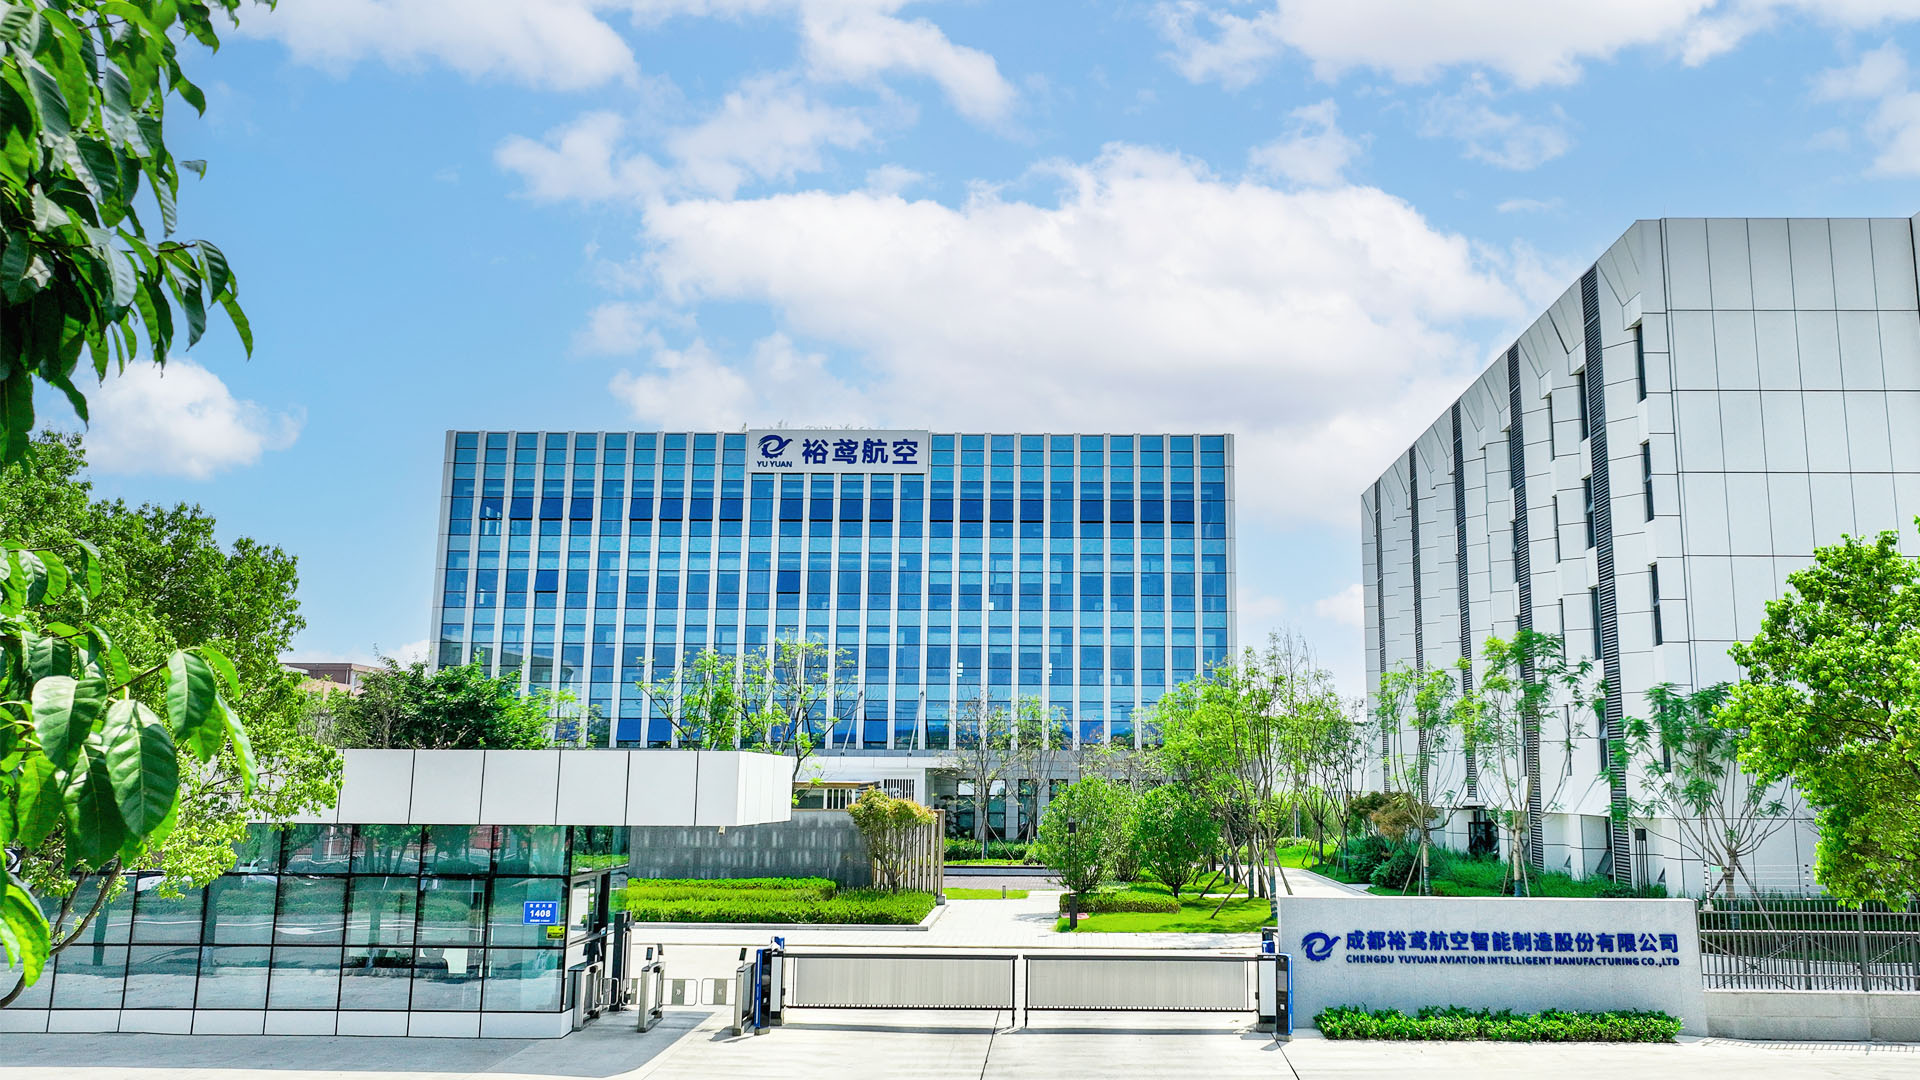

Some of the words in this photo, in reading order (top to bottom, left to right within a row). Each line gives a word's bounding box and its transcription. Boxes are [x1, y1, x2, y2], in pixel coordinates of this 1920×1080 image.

[802, 438, 918, 464] 裕鸢航空
[1346, 930, 1678, 953] 成都裕鸢航空智能制造股份有限公司
[1346, 955, 1394, 963] CHENGDU
[1398, 955, 1437, 964] YUYUAN
[1439, 955, 1485, 964] AVIATION
[1487, 956, 1551, 965] INTELLIGENT
[1554, 957, 1639, 966] MANUFACTURING
[1641, 957, 1680, 967] CO.,LTD
